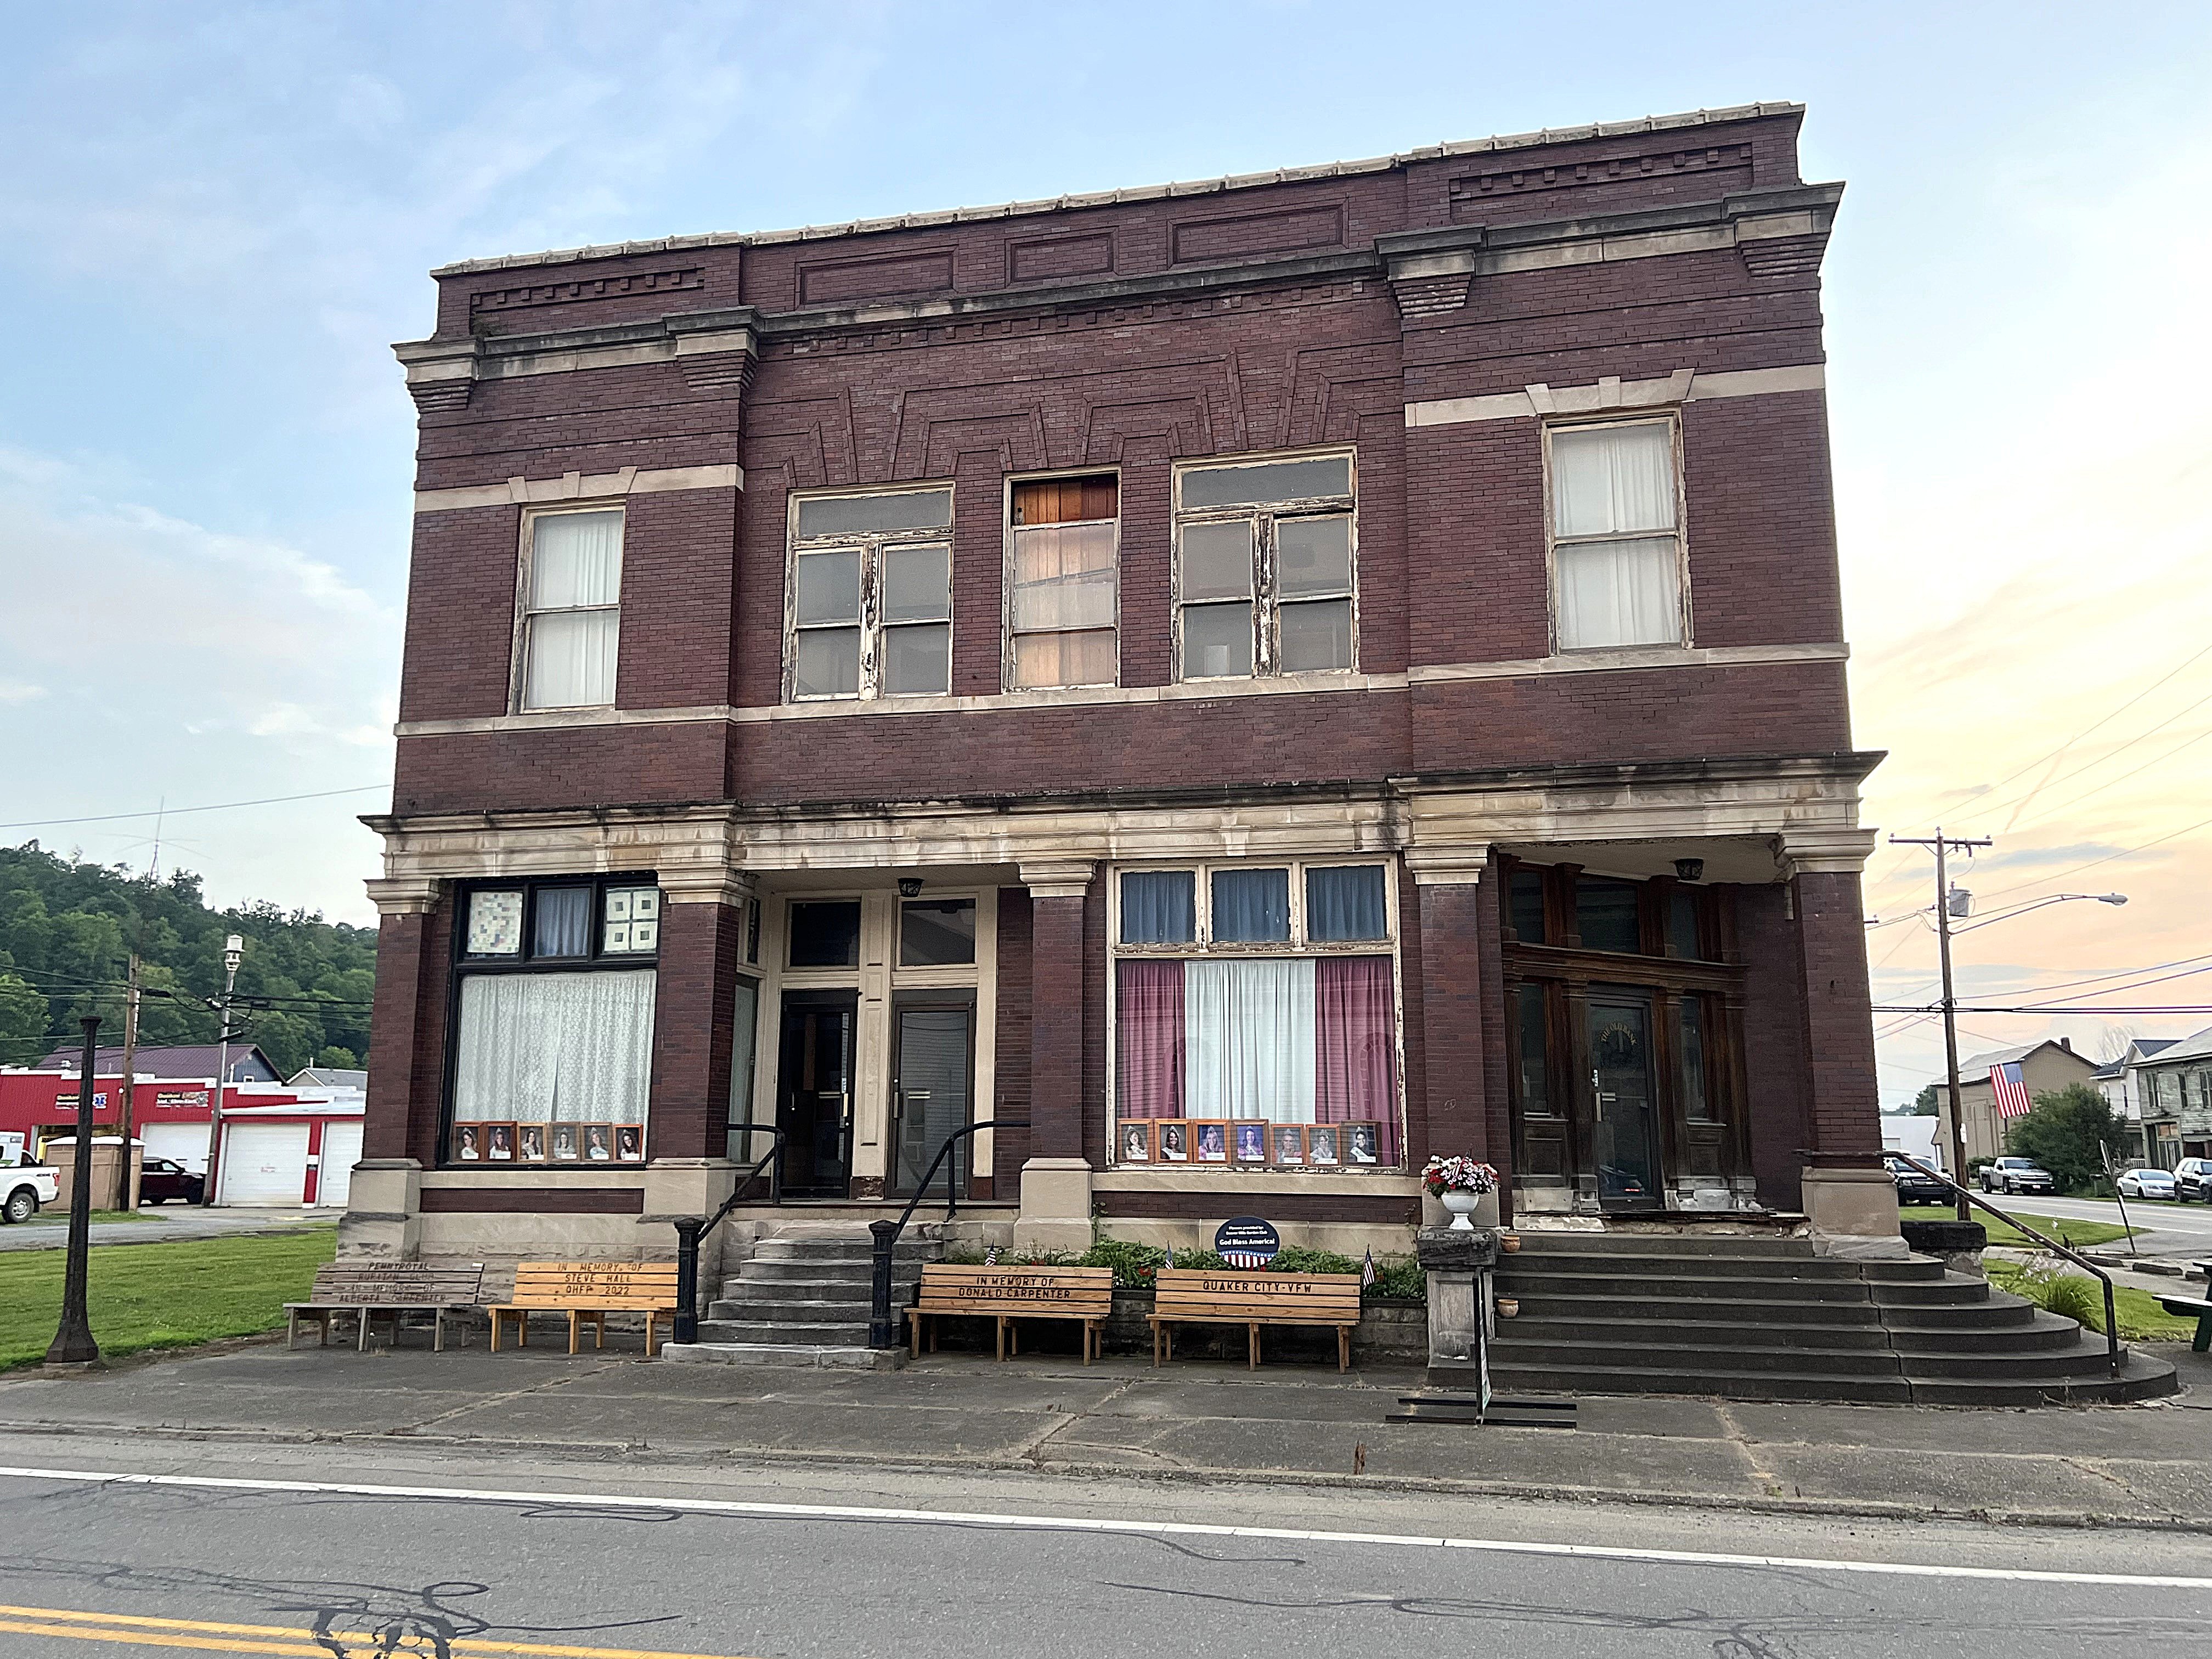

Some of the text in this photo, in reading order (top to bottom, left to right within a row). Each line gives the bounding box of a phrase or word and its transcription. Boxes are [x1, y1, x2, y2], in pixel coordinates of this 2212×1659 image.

[557, 1262, 644, 1272] IN MEMORY OF
[565, 1273, 632, 1283] STEVE HALL
[977, 1276, 1054, 1287] IN MEMORY OF
[605, 1286, 630, 1295] 2022
[1203, 1281, 1249, 1291] QUAKER
[958, 1288, 1070, 1299] DONALD CARPENTER
